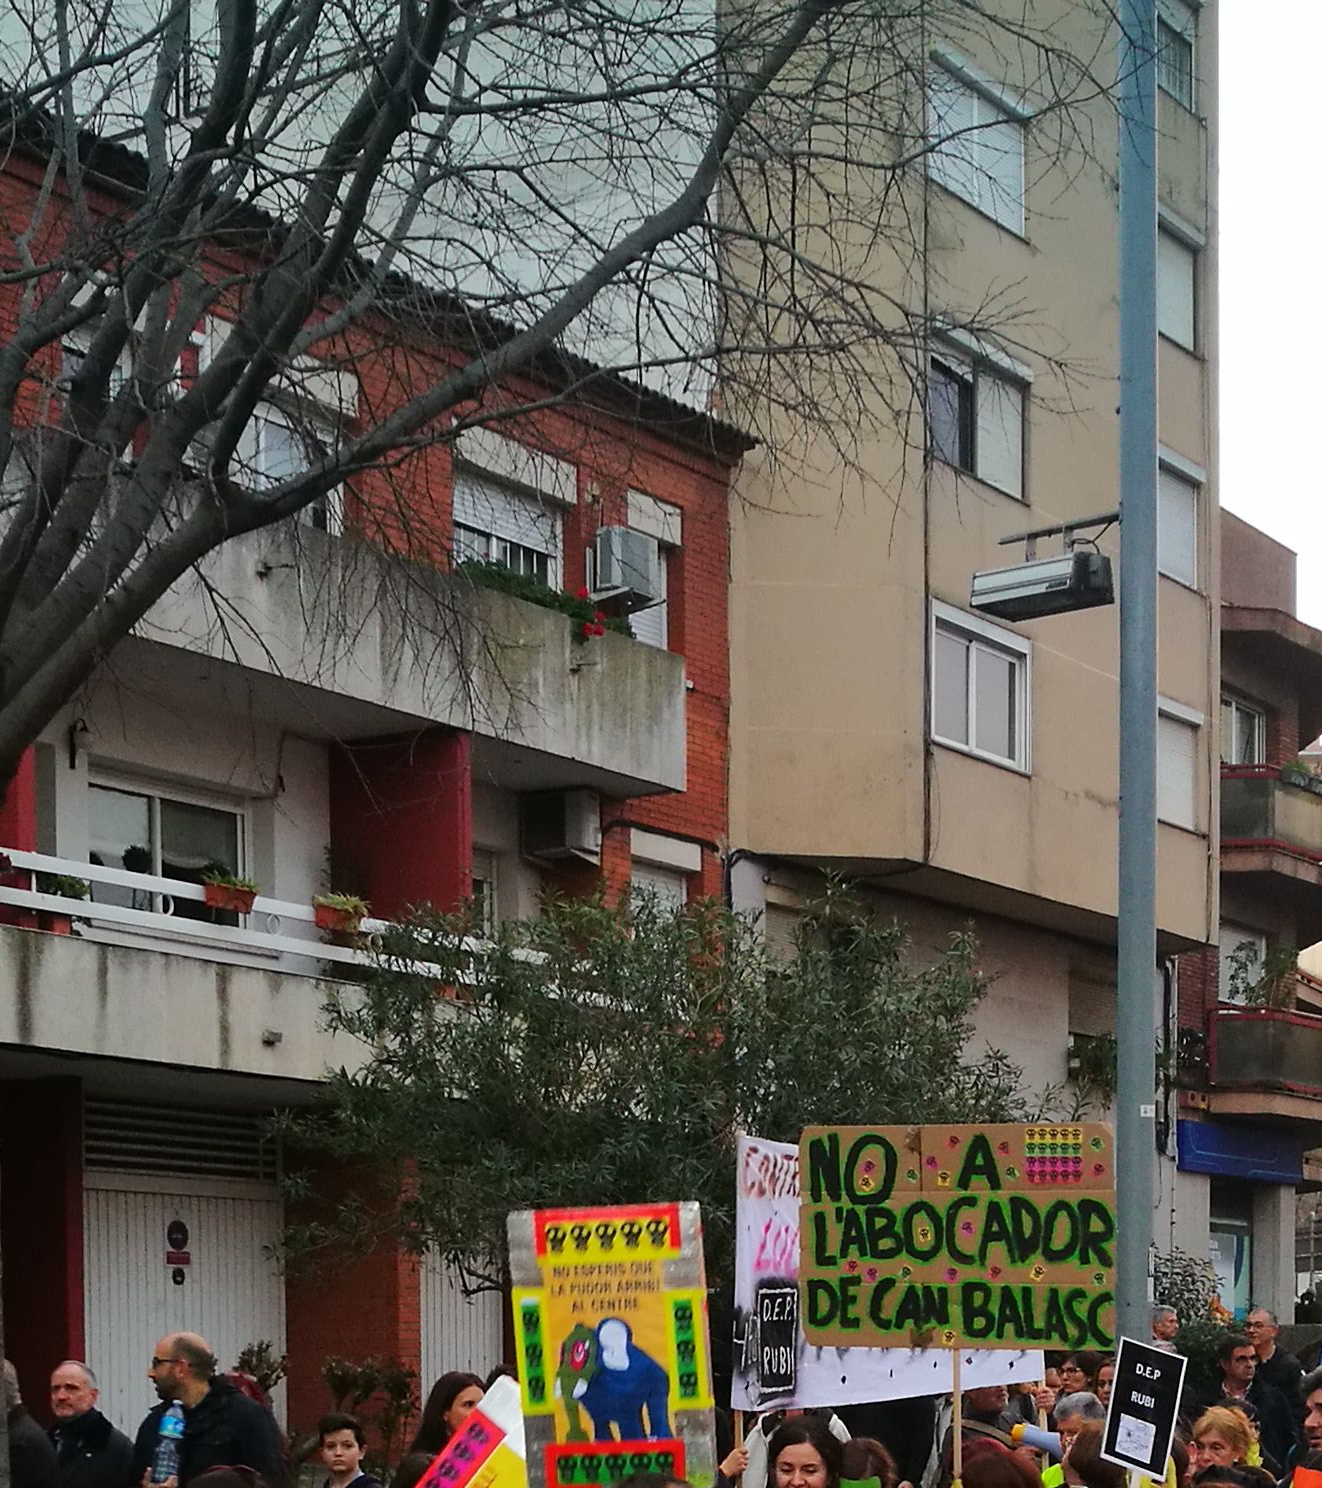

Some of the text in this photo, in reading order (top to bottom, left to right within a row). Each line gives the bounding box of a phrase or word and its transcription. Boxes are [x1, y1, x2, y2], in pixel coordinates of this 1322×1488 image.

[809, 1133, 1002, 1206] NO A
[813, 1196, 1115, 1268] L'ABOCADOR
[807, 1275, 1114, 1348] DE CAN BALASC
[763, 1347, 791, 1376] RUBI
[1135, 1363, 1161, 1380] D.E.P
[1130, 1391, 1155, 1409] RUBI
